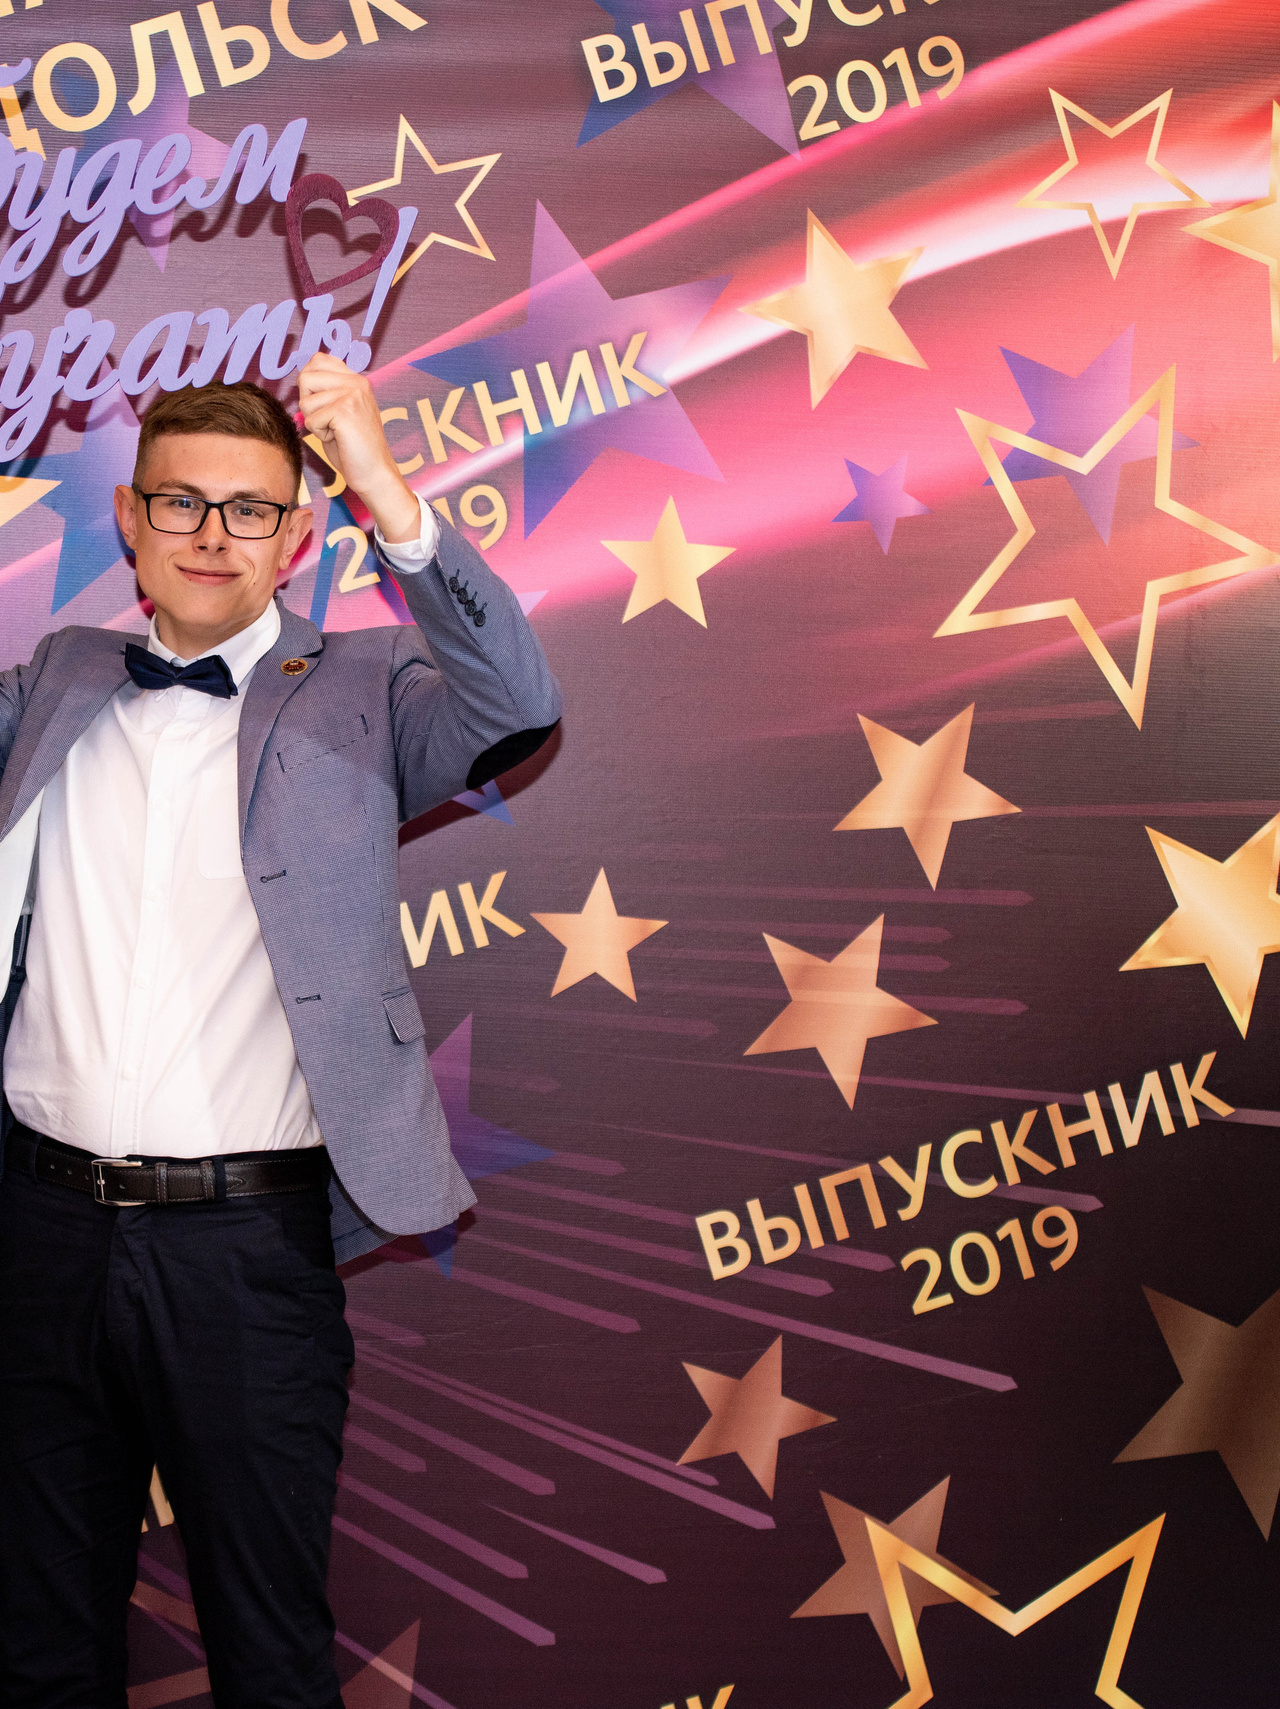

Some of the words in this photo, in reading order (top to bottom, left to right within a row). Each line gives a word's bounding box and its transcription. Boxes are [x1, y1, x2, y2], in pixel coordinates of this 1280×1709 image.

[787, 35, 965, 141] 2019
[695, 1051, 1236, 1280] ВЫПУСКНИК
[900, 1205, 1080, 1316] 2019
